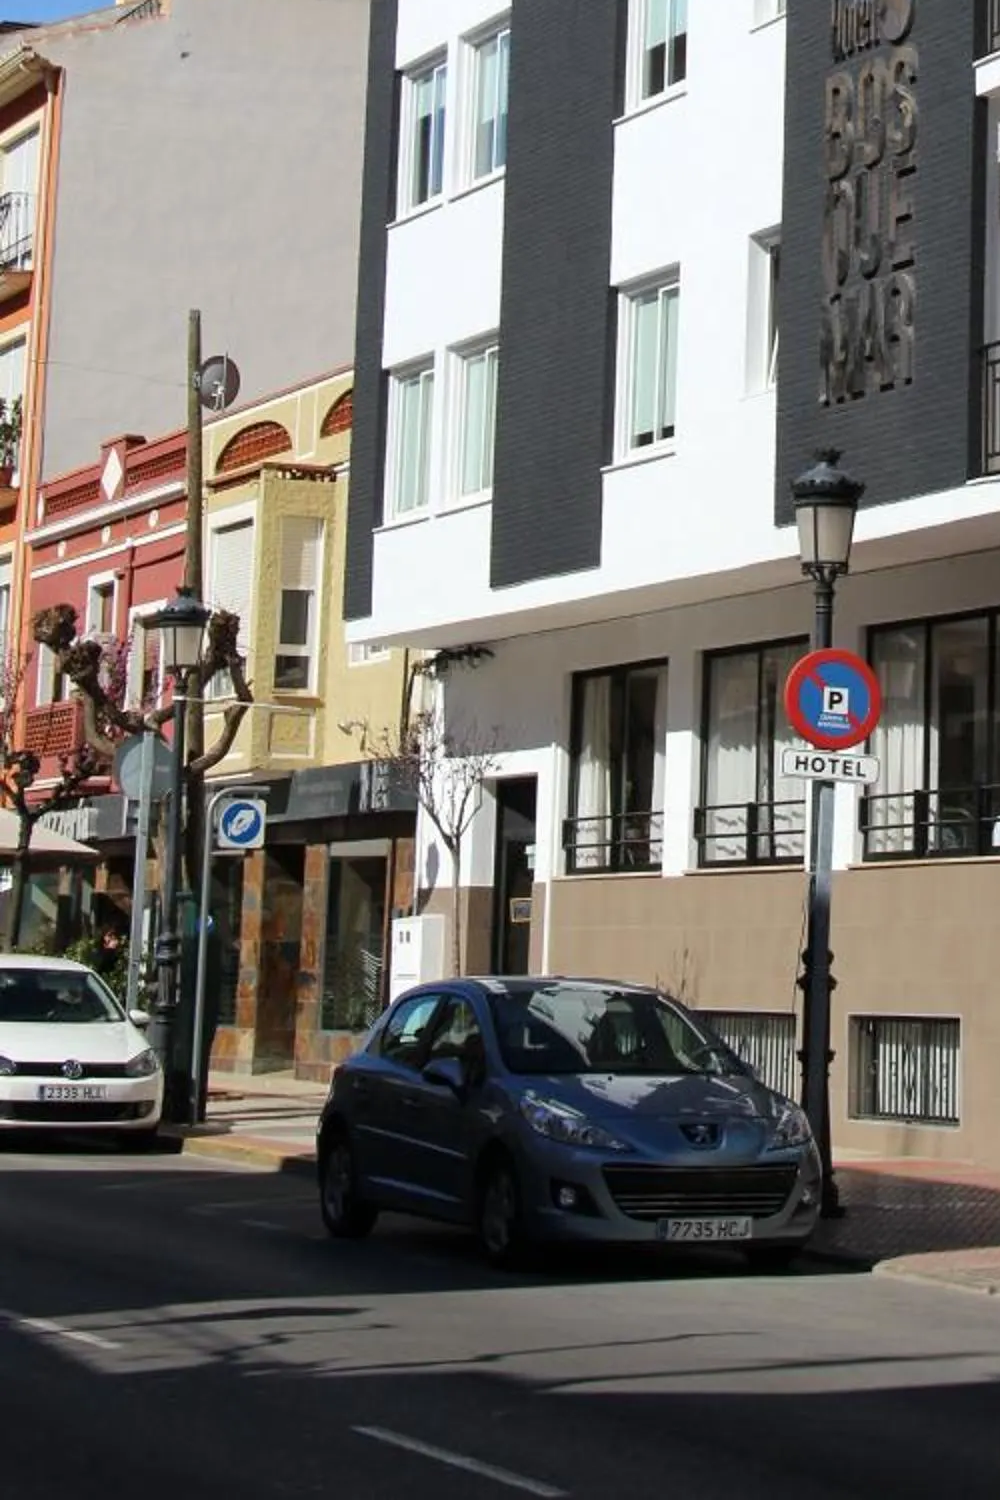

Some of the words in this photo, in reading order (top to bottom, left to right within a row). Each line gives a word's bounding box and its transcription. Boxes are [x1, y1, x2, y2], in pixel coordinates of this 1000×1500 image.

[828, 691, 843, 710] P
[795, 755, 866, 777] HOTEL
[671, 1221, 714, 1238] 7735
[718, 1219, 750, 1237] HCJ
